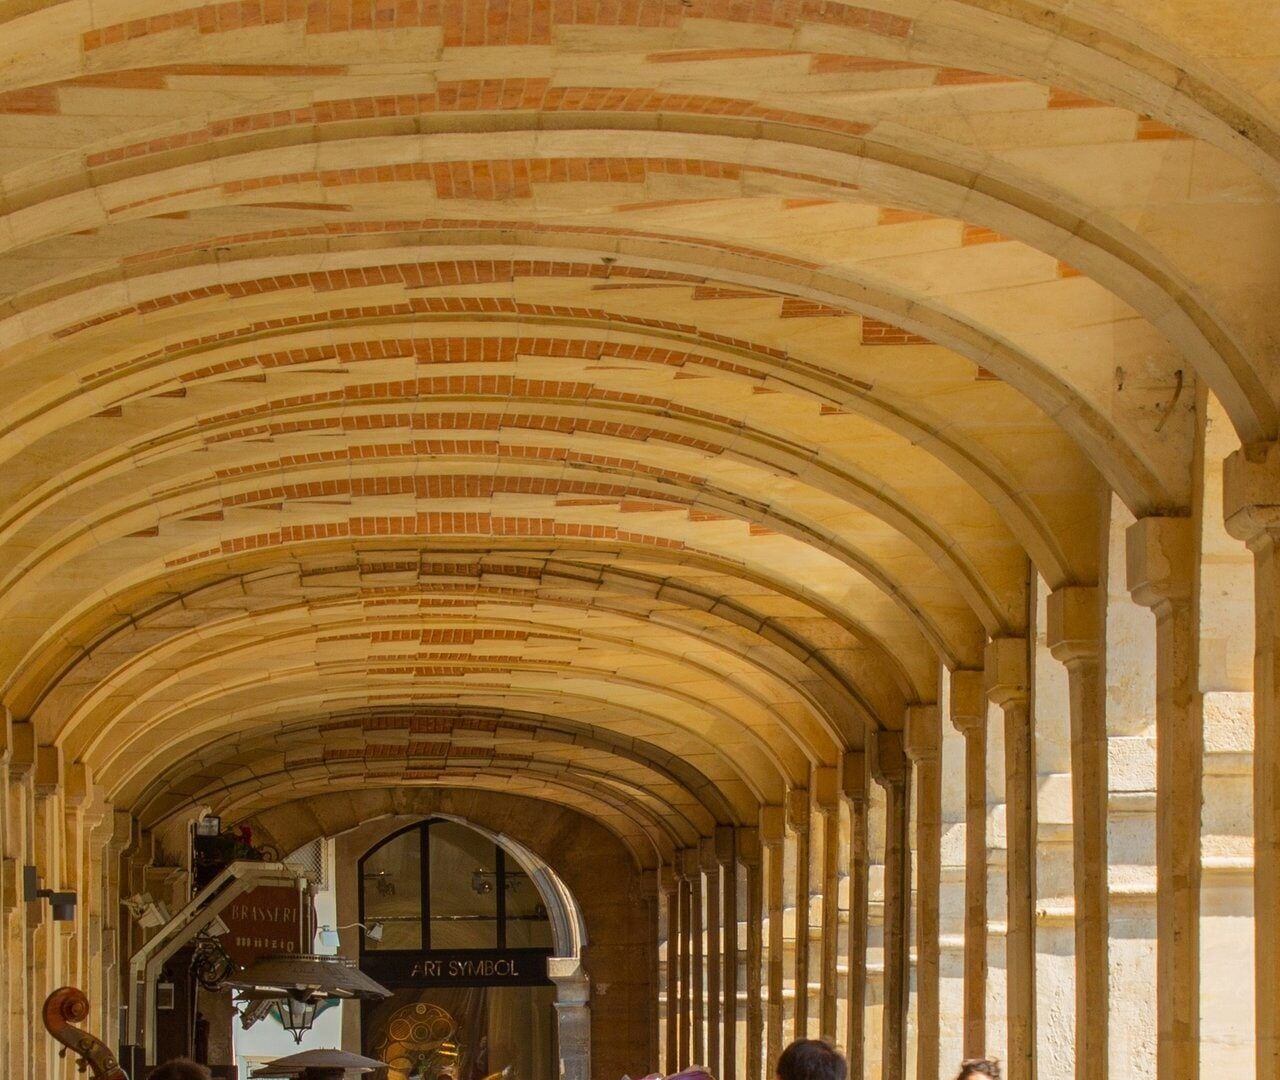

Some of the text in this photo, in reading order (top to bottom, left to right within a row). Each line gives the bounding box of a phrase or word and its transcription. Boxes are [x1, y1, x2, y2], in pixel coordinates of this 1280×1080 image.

[231, 904, 300, 923] BRASSERI
[411, 959, 520, 977] ART SYMBOL
